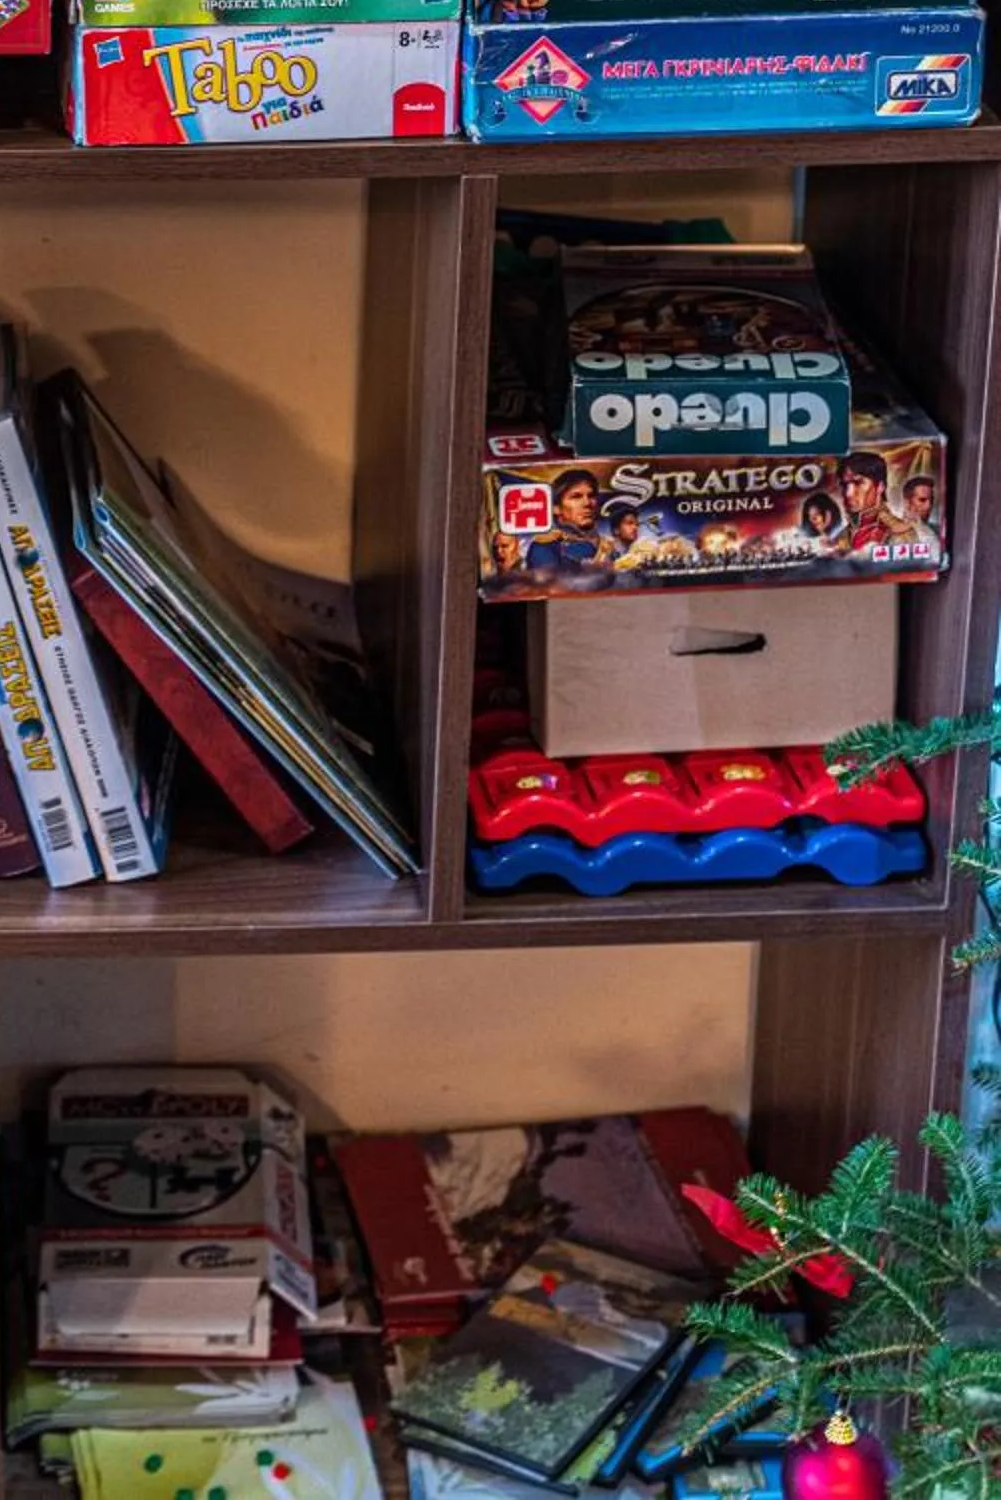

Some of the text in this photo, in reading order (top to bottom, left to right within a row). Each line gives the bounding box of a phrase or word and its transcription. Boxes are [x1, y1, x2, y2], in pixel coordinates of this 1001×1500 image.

[94, 3, 136, 14] GAMES
[201, 0, 259, 11] ΠΡΟΣΕΧΕ
[263, 0, 278, 9] ΤΑ
[143, 38, 319, 117] Taboo
[602, 61, 659, 80] ΜΕΓΑ
[677, 497, 774, 514] ORIGINAL
